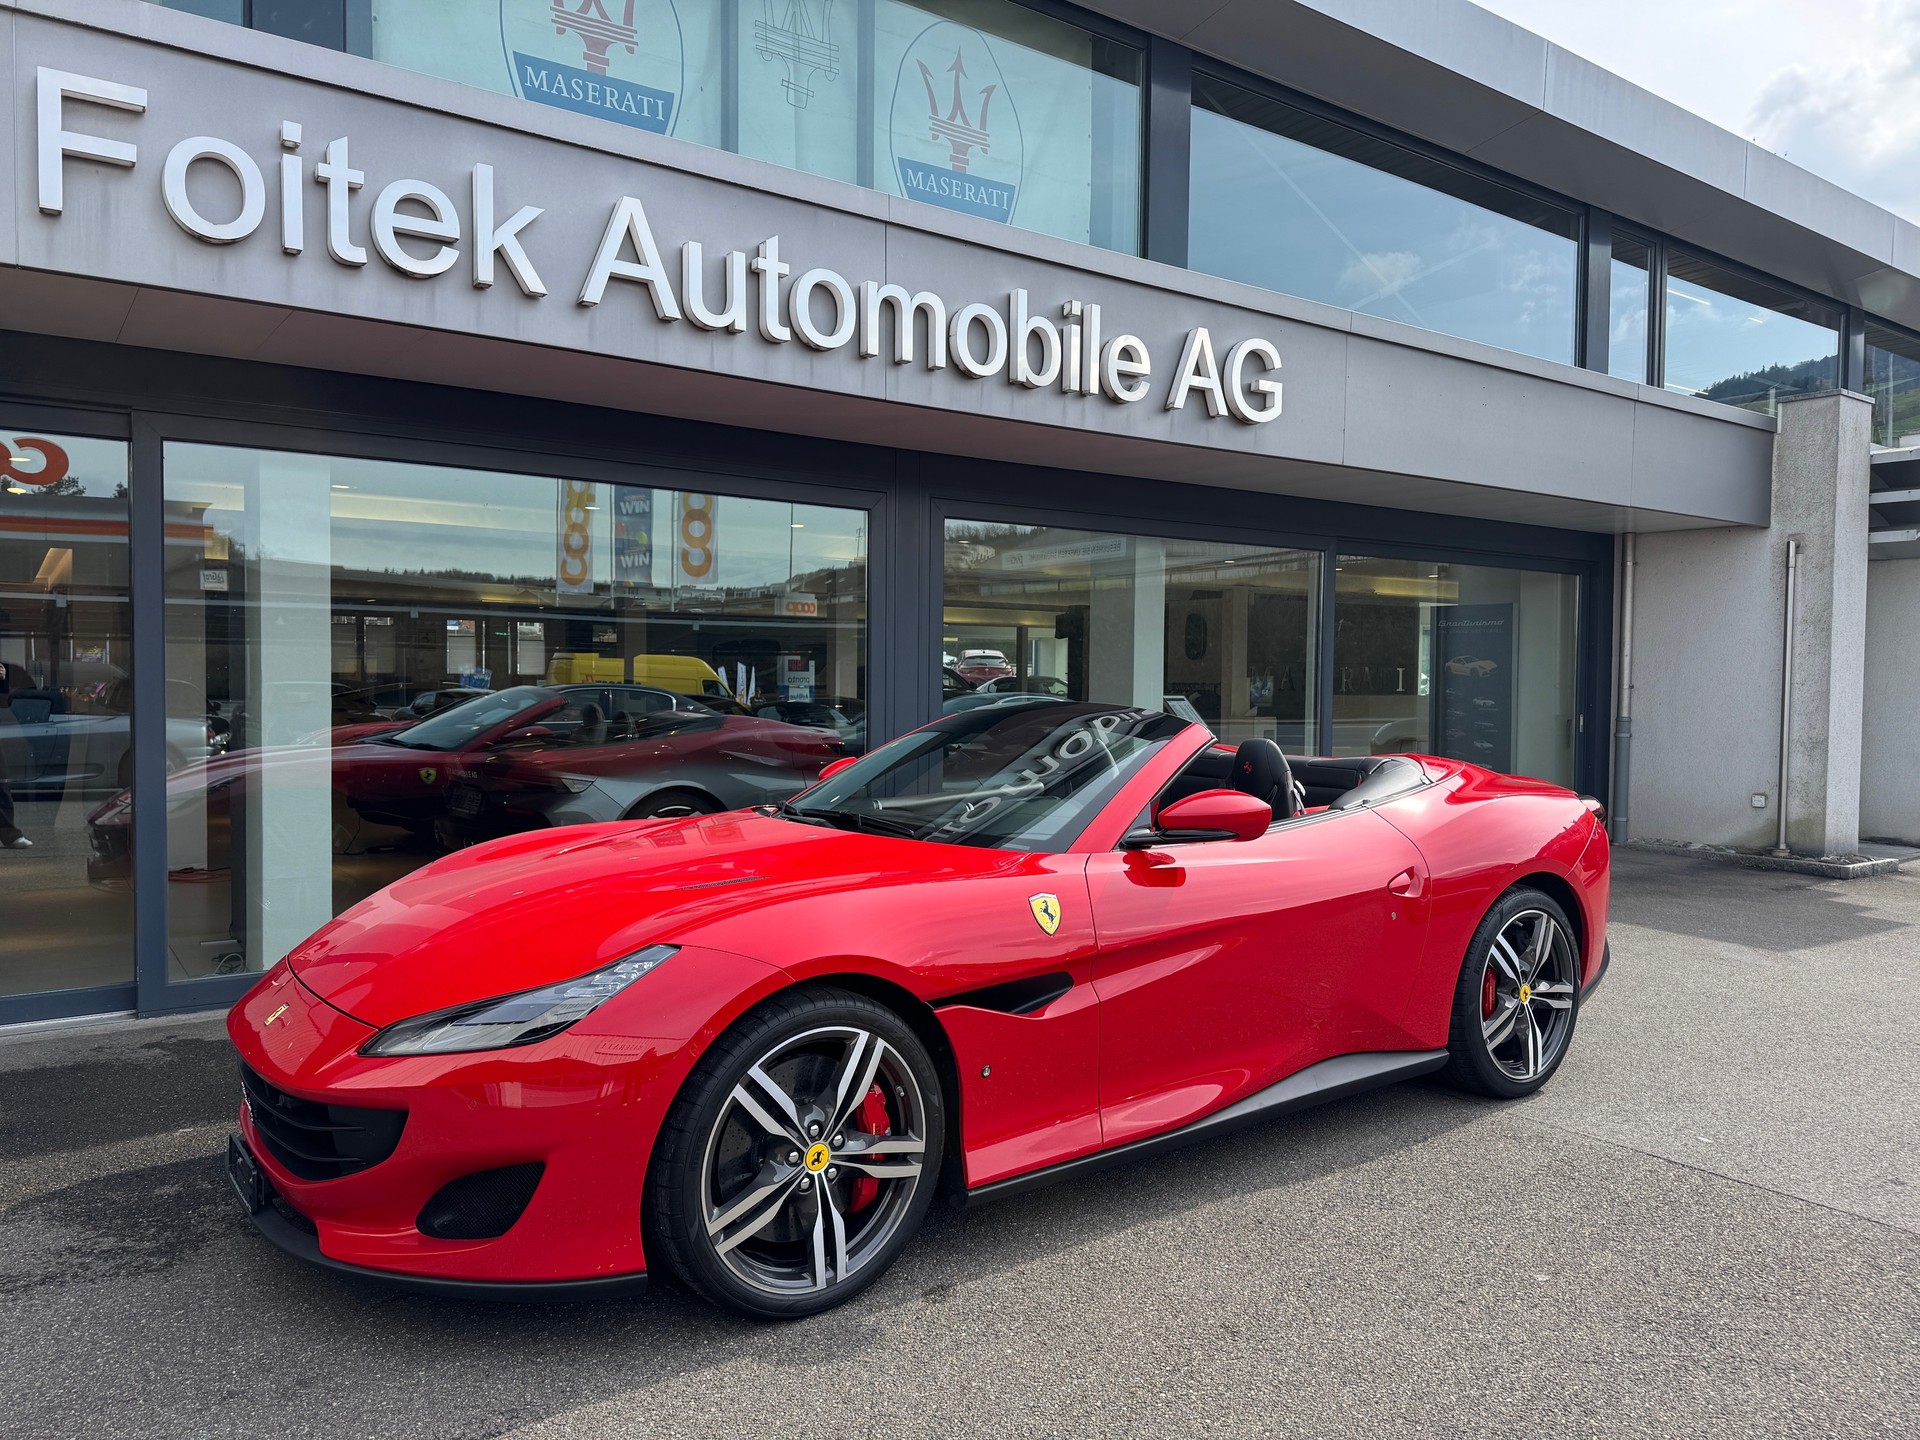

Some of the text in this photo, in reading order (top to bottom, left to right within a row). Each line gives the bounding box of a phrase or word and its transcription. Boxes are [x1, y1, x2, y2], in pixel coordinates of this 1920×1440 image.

[523, 63, 667, 123] MASERATI
[905, 166, 1011, 213] MASERATI
[36, 66, 1284, 425] Foitek Automobile AG
[619, 499, 650, 515] WIN
[619, 551, 650, 569] WIN
